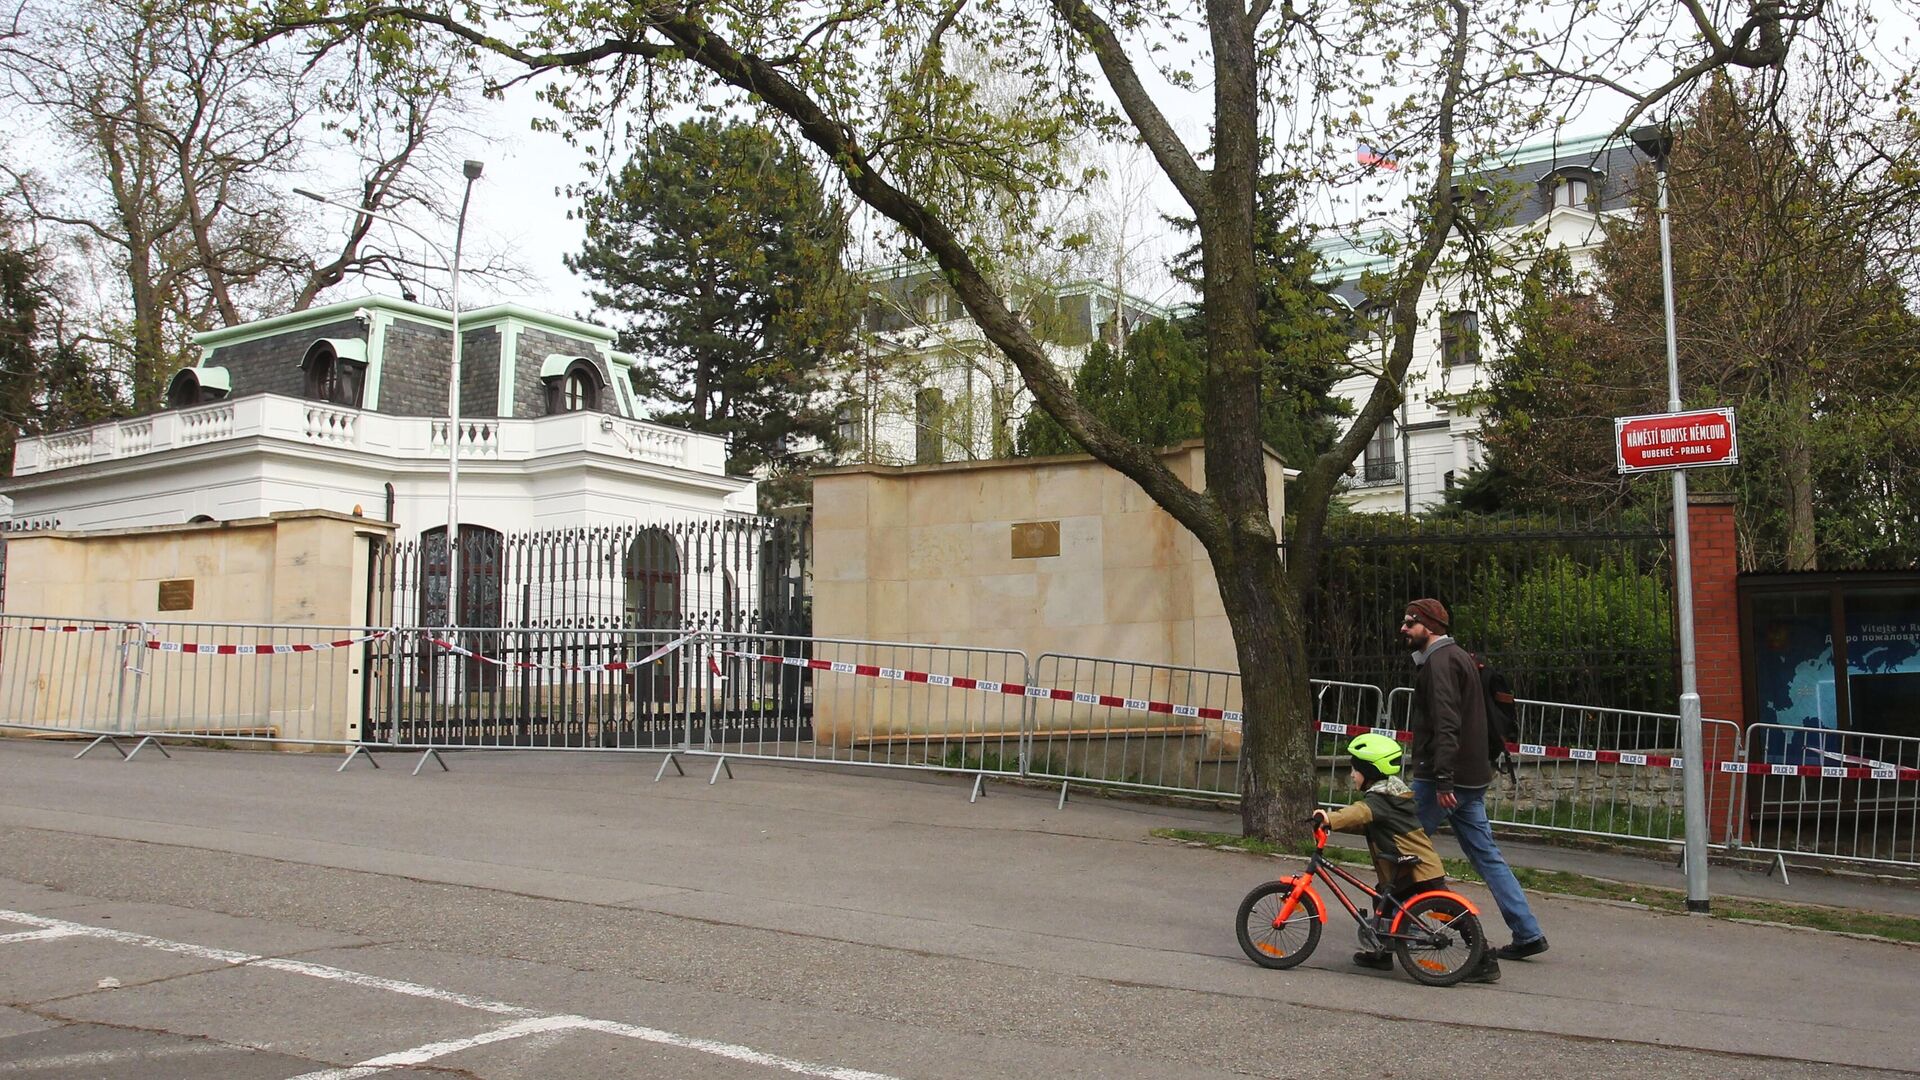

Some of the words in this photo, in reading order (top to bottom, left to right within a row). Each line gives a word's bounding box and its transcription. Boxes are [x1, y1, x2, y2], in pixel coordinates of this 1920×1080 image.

[1627, 427, 1658, 447] NÁMĚSTÍ
[1661, 428, 1687, 443] BORISE
[1690, 424, 1725, 440] NĚMCOVA
[1642, 446, 1674, 458] BUBENEČ
[1681, 446, 1705, 455] PRAHA
